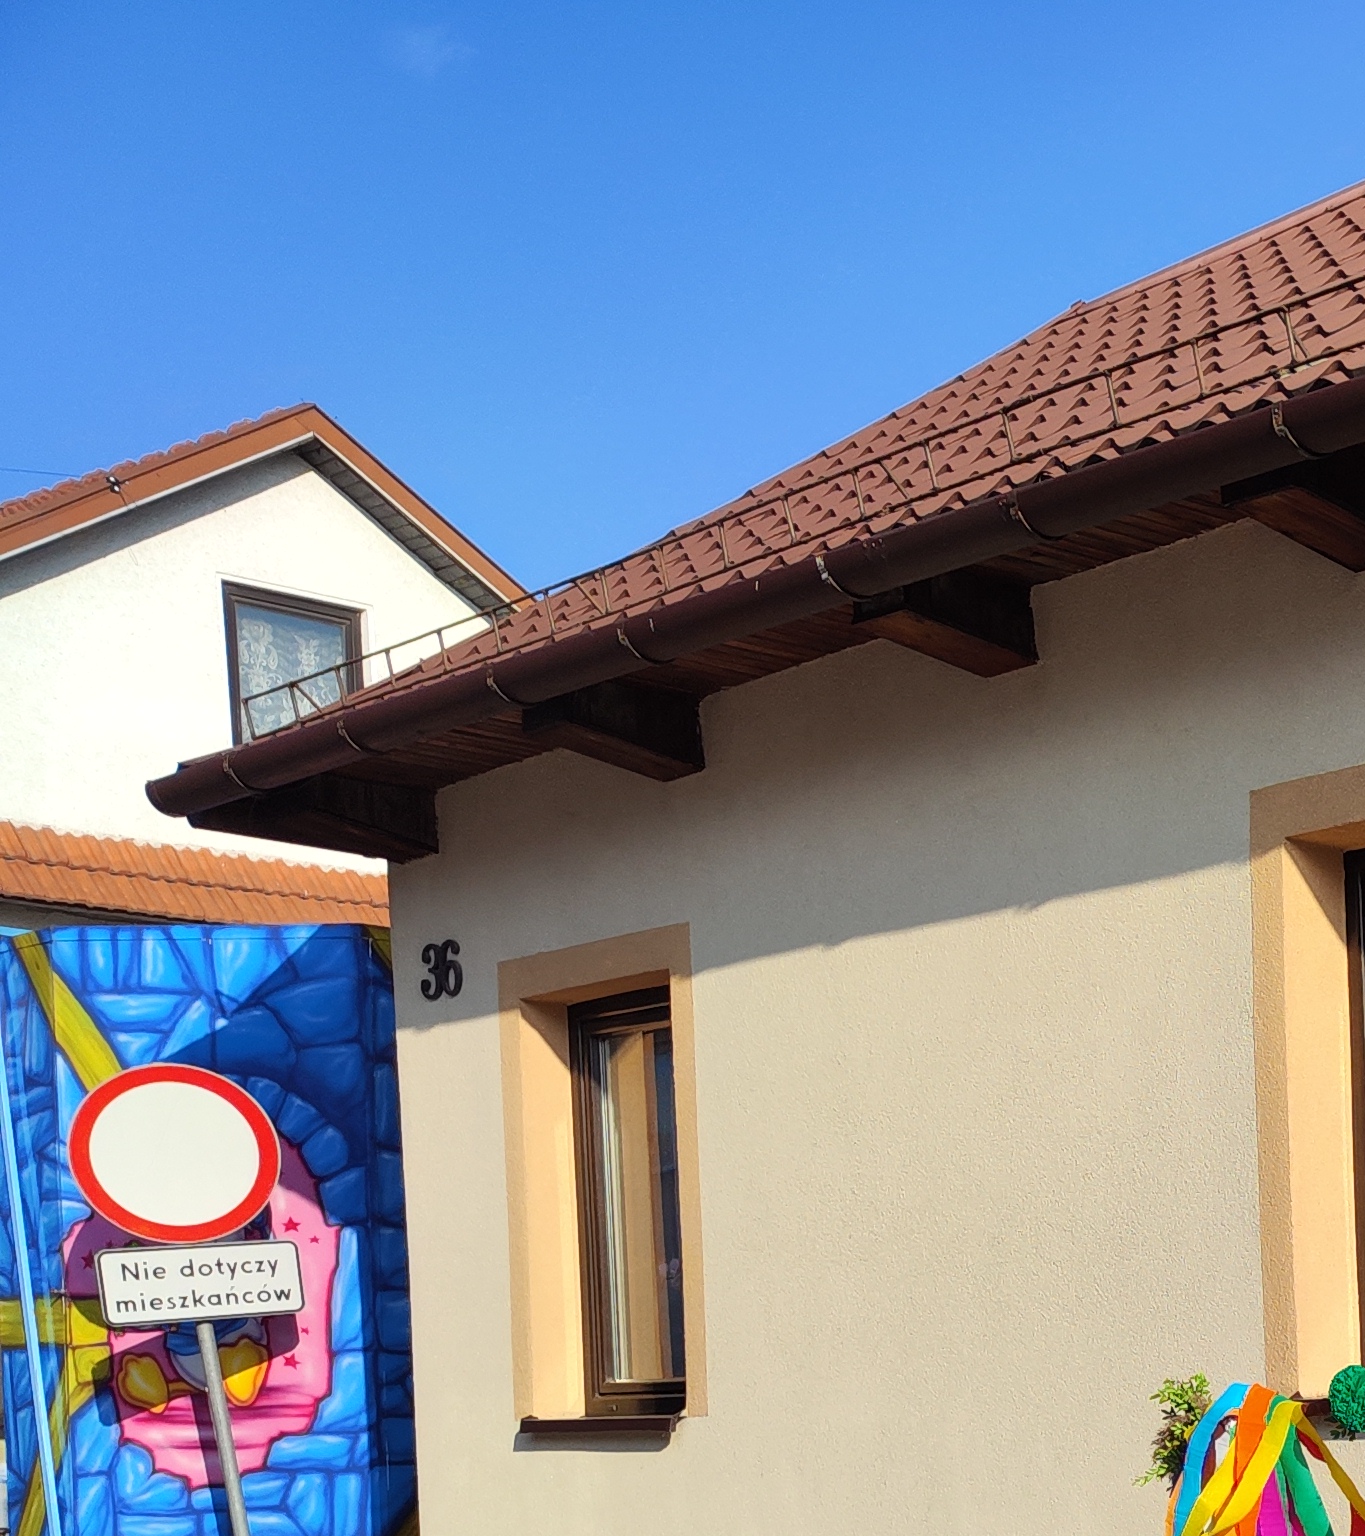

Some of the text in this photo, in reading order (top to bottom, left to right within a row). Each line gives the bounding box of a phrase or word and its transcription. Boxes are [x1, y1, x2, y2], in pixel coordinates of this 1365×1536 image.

[421, 939, 463, 1001] 36
[121, 1258, 278, 1281] Nie dotyczy
[116, 1284, 291, 1313] mieszkańców
